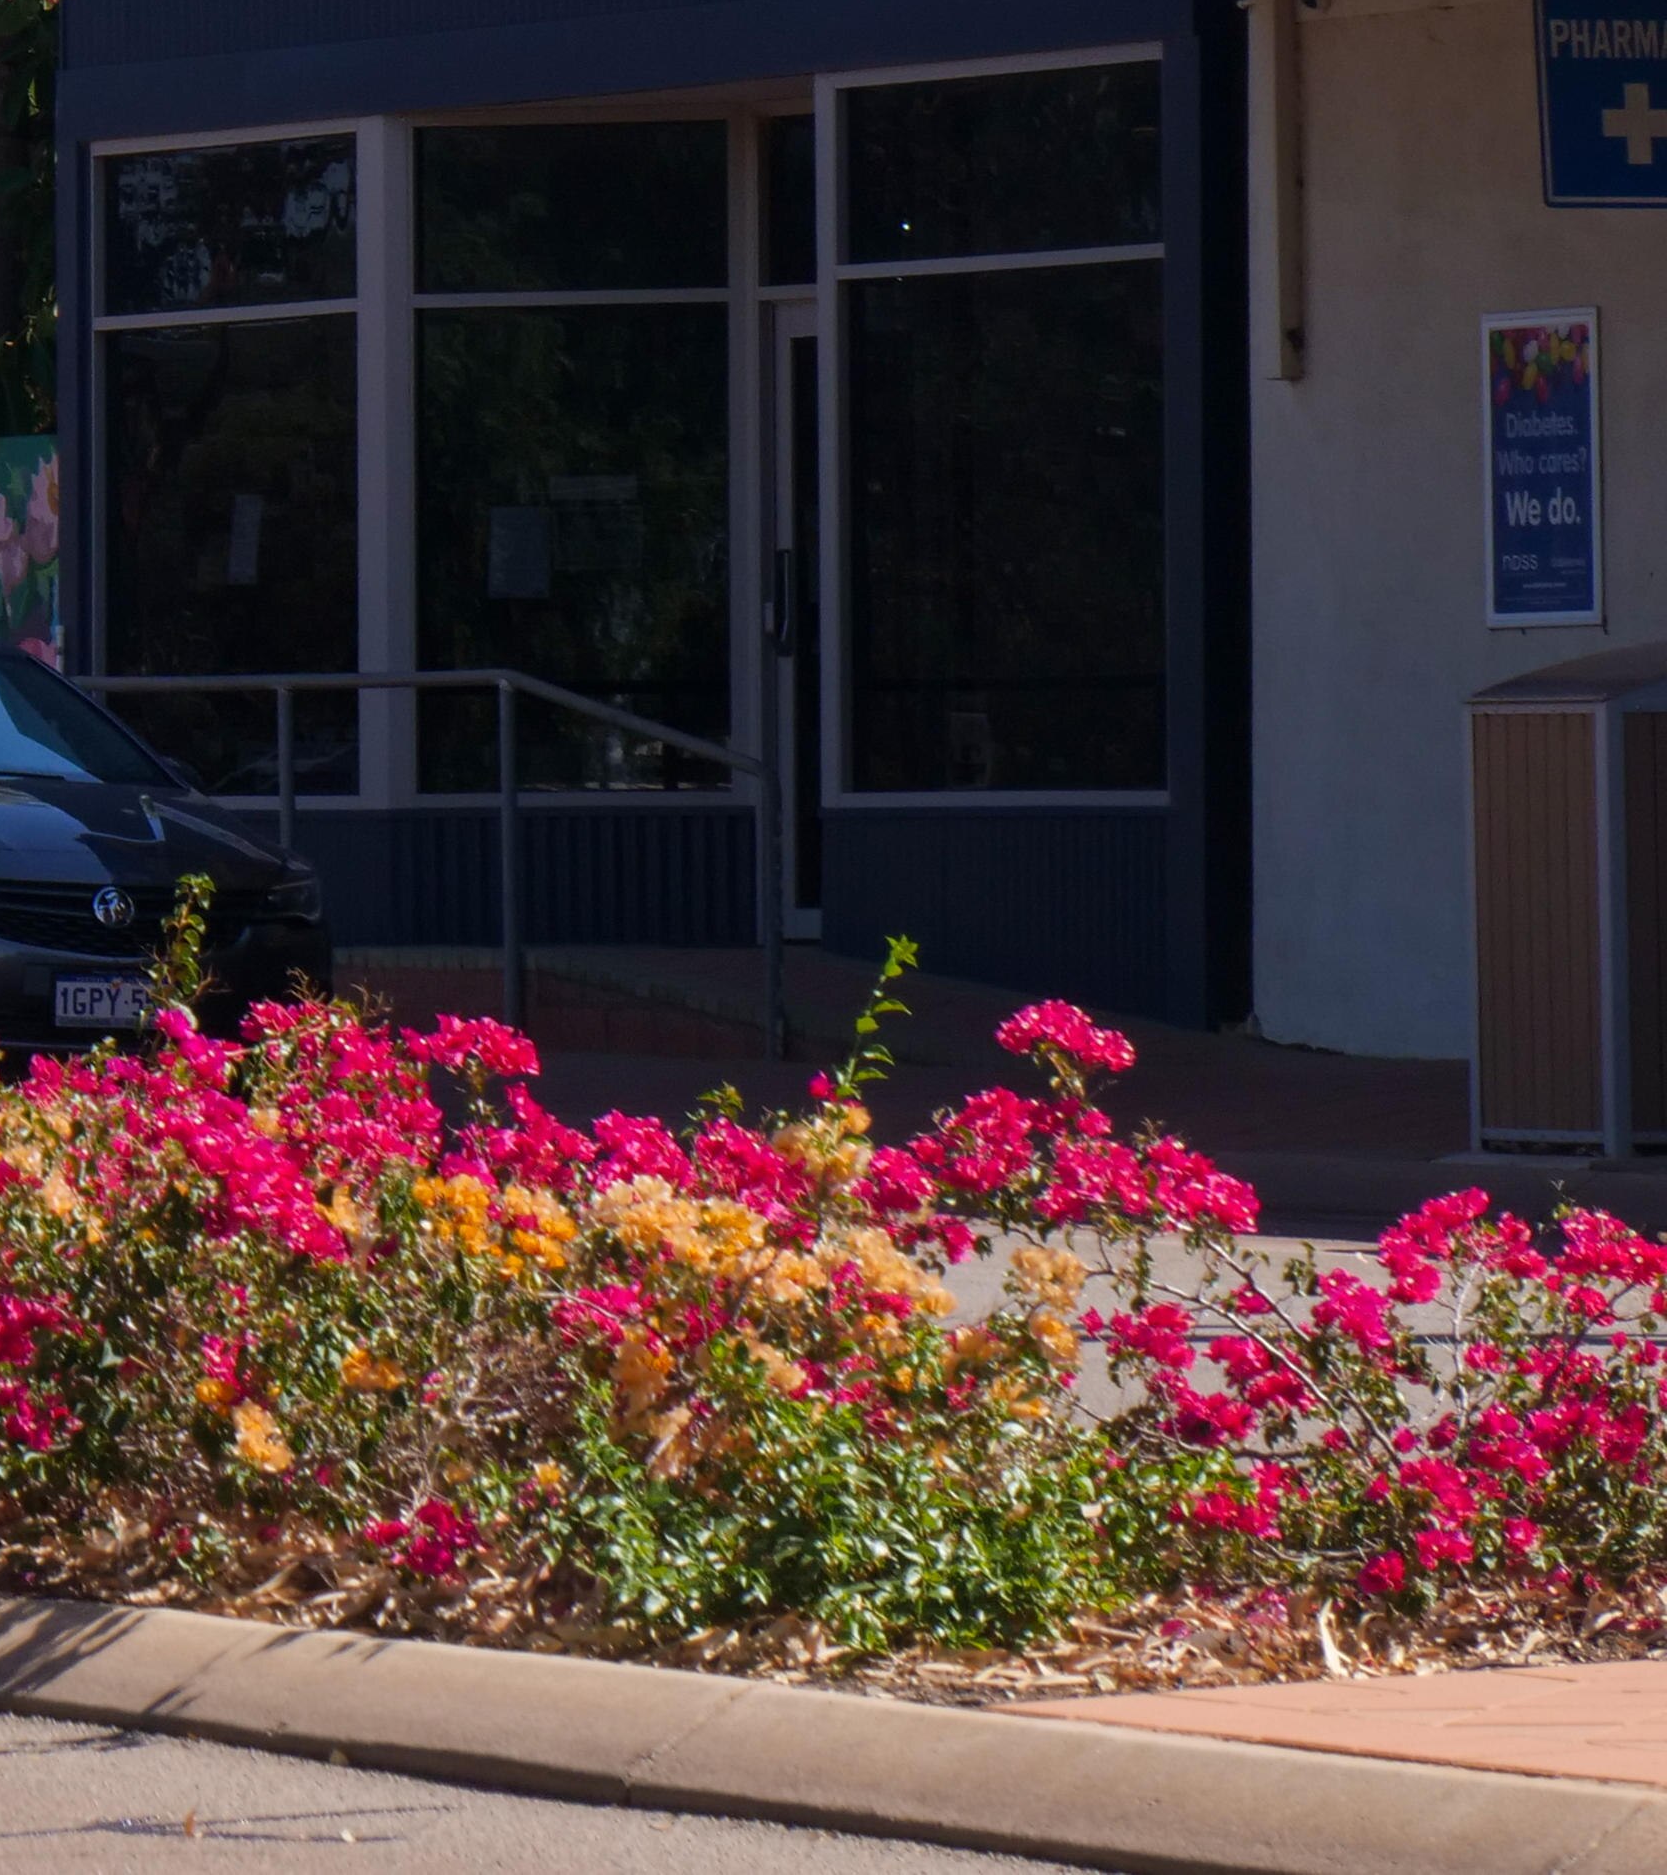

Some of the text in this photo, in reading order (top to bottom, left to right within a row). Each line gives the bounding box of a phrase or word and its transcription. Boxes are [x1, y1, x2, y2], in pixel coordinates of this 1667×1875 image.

[1497, 447, 1587, 475] Who cares?
[1505, 486, 1582, 527] We do.
